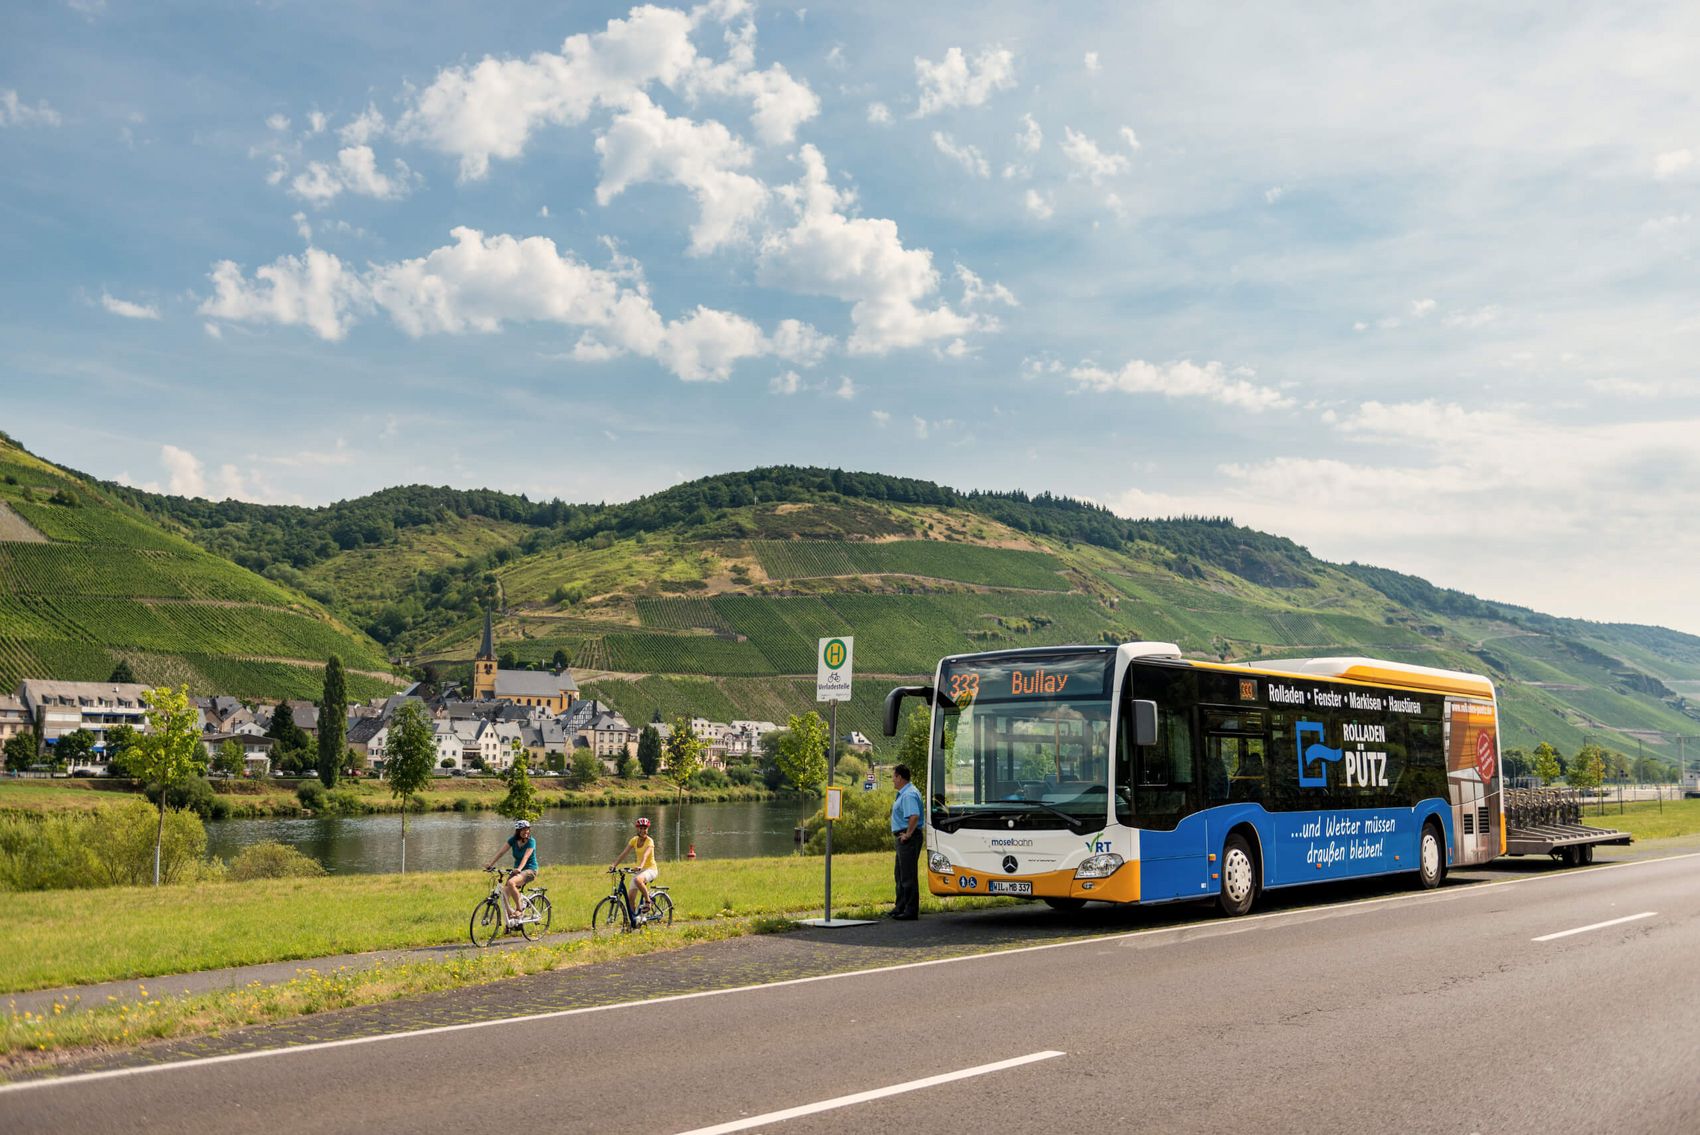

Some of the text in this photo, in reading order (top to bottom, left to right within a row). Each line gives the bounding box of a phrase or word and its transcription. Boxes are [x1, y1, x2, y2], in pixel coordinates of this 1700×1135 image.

[830, 646, 841, 663] H
[949, 670, 1069, 698] 333 Bullay
[1268, 683, 1422, 715] Rolladen Fenster Markisen Haustüren
[1342, 723, 1386, 742] ROLLADEN
[1344, 743, 1389, 787] PÜTZ
[1291, 815, 1396, 838] ...und Wetter müssen
[1085, 832, 1112, 853] VRT
[1306, 838, 1384, 867] draußen bleiben!
